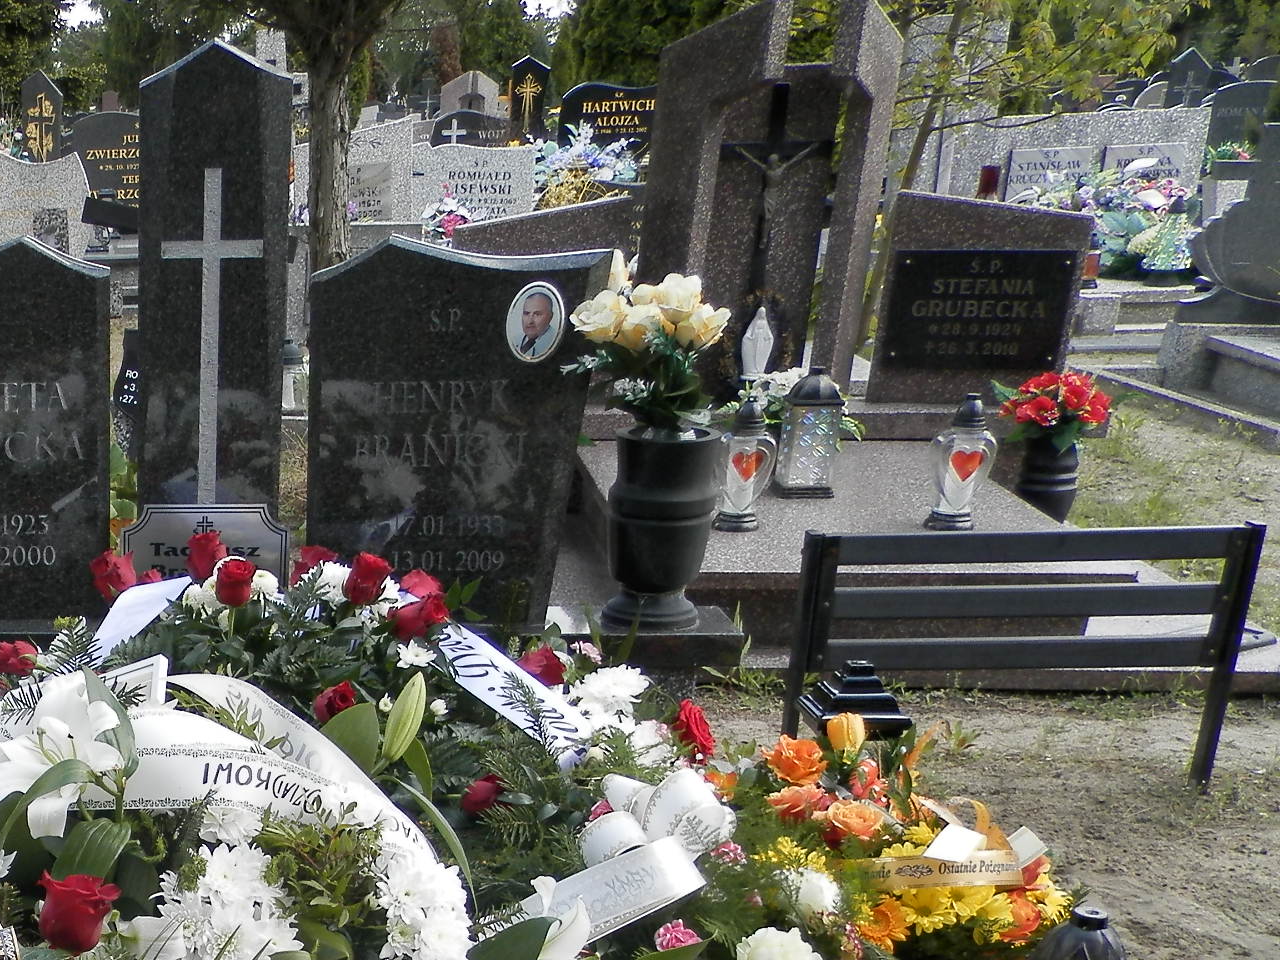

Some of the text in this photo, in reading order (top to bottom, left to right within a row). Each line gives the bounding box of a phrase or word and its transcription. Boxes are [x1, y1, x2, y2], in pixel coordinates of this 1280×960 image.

[583, 99, 656, 113] HARTWICH
[595, 115, 639, 127] ALOJZA
[932, 278, 1035, 295] STEFANIA
[911, 300, 1047, 318] GRUBECKA
[373, 379, 513, 415] HENRYK
[938, 861, 977, 875] Ostatnie
